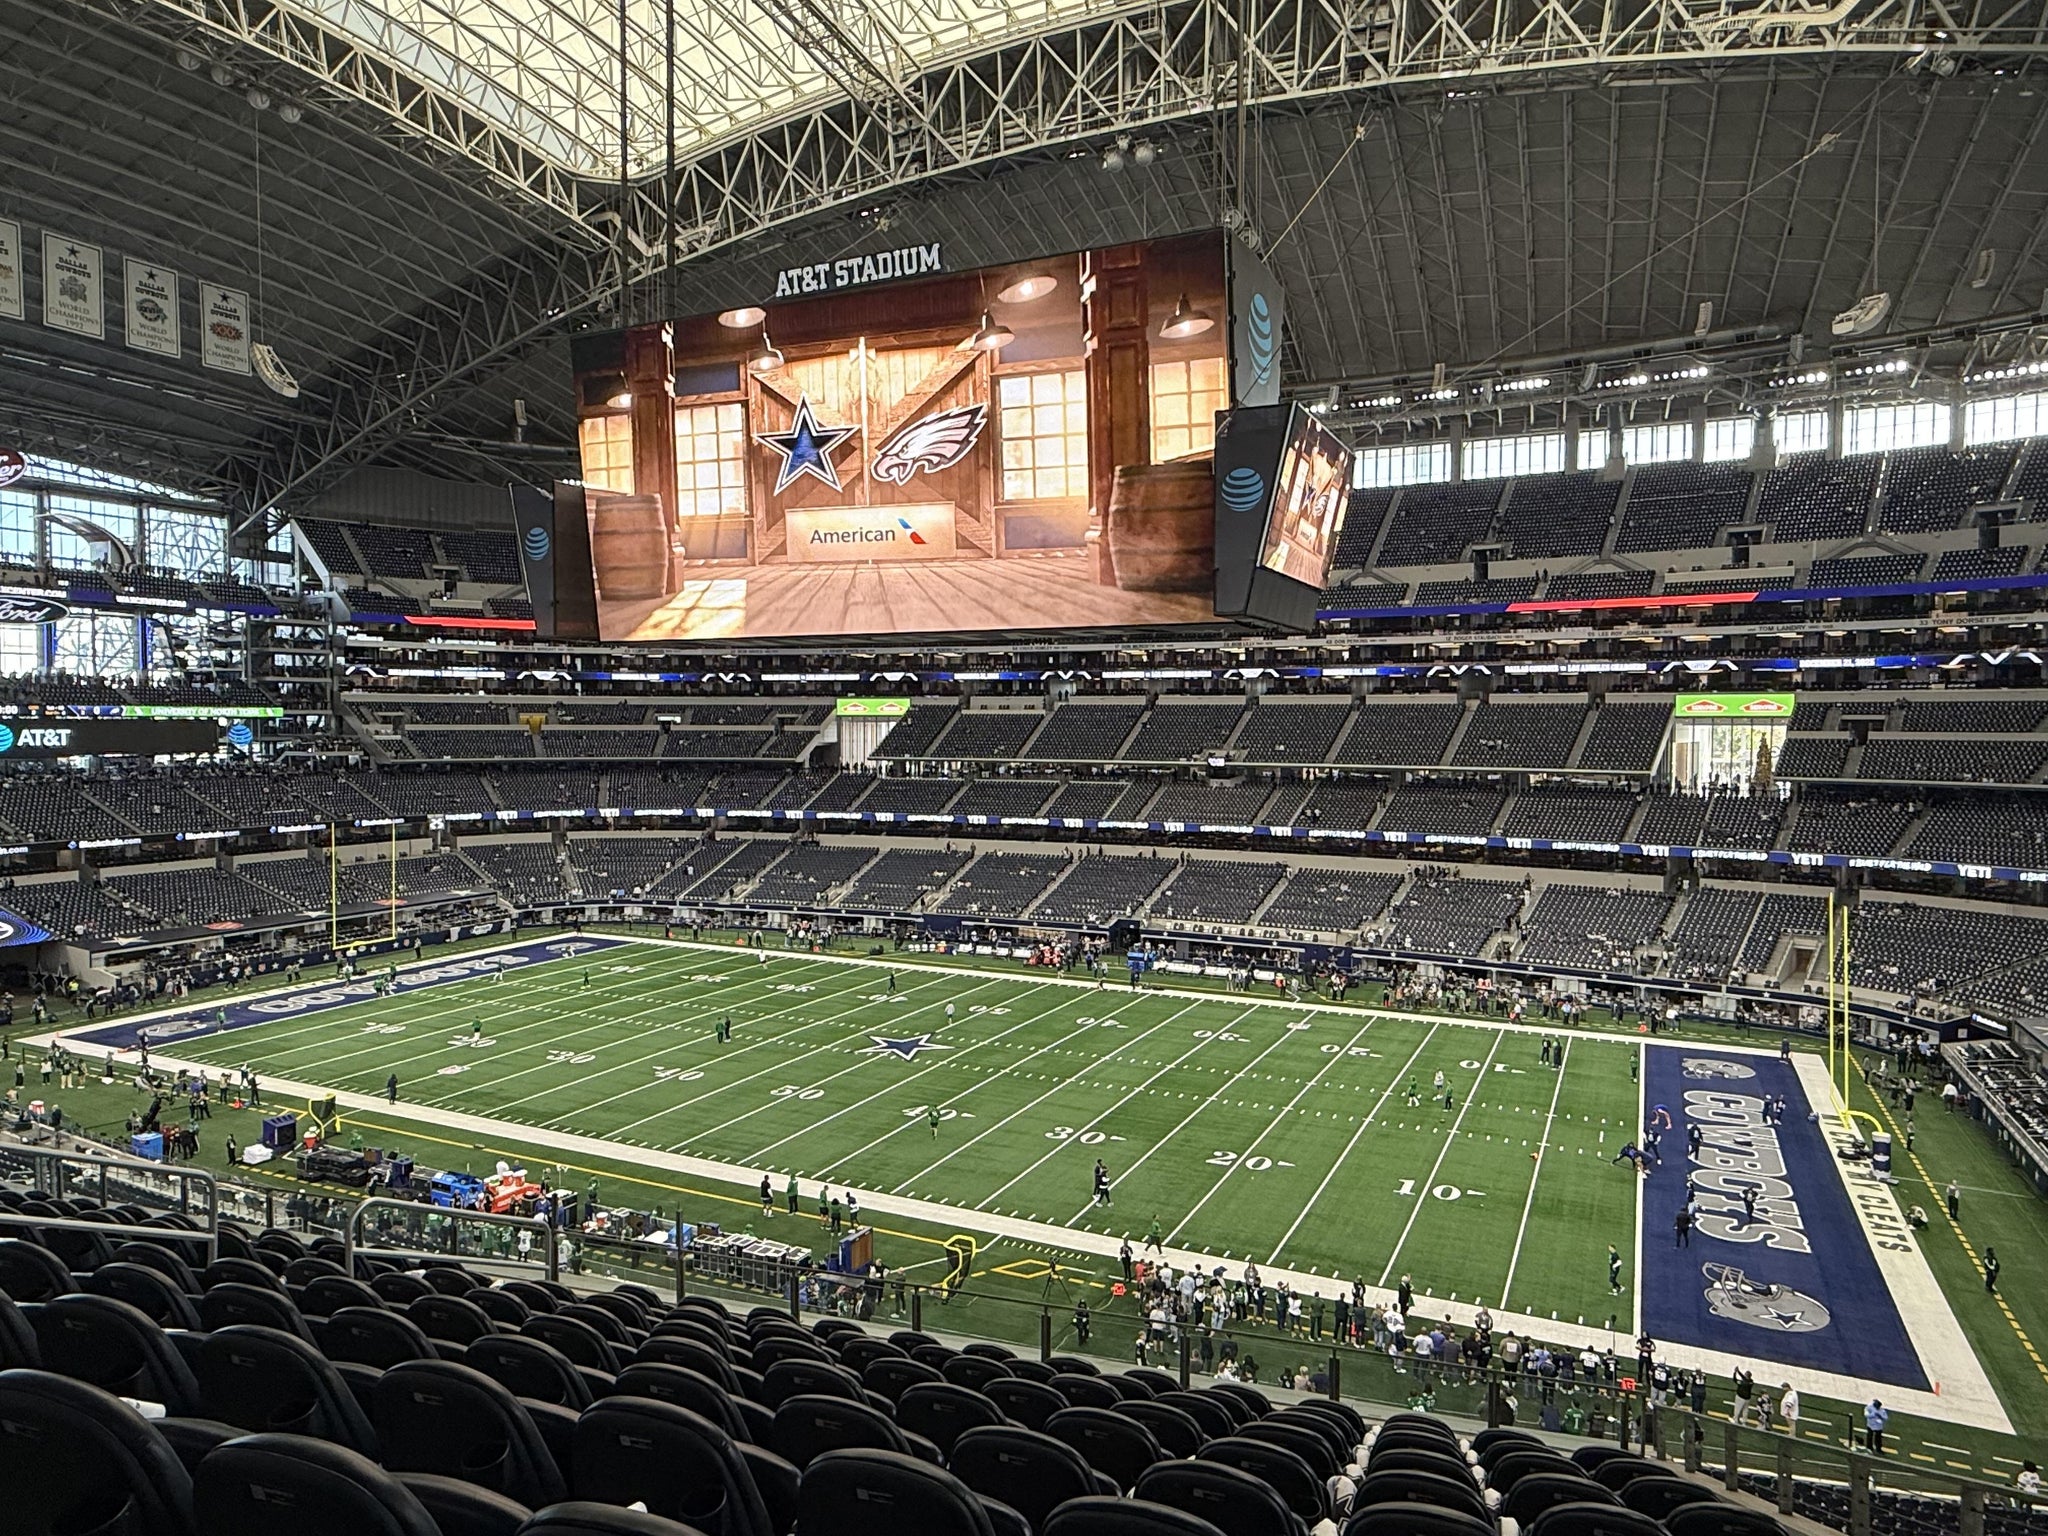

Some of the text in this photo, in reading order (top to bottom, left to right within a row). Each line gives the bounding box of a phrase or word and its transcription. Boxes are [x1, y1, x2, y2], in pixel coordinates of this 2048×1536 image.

[58, 256, 88, 270] DALLAS
[775, 242, 941, 297] AT&T STADIUM
[55, 263, 92, 278] COWBOYS
[138, 280, 165, 293] DALLAS
[58, 300, 90, 315] WORLD
[212, 302, 238, 314] DALLAS
[139, 322, 168, 335] WORLD
[213, 343, 240, 355] WORLD
[810, 527, 896, 544] American
[17, 728, 72, 746] AT&T
[1062, 818, 1084, 828] YETI
[1163, 821, 1185, 832] YETI
[1269, 825, 1292, 837] YETI
[1382, 831, 1408, 842] YETI
[1506, 837, 1532, 849] YETI
[1641, 844, 1670, 857] YETI
[1791, 852, 1824, 866] YETI
[1957, 863, 1993, 880] YETI
[769, 1083, 826, 1100] 50
[1043, 1125, 1107, 1145] 30
[1205, 1150, 1274, 1171] 20
[1682, 1089, 1813, 1254] COWBOYS
[1392, 1177, 1463, 1201] 10
[1856, 1193, 1913, 1253] CLEATS
